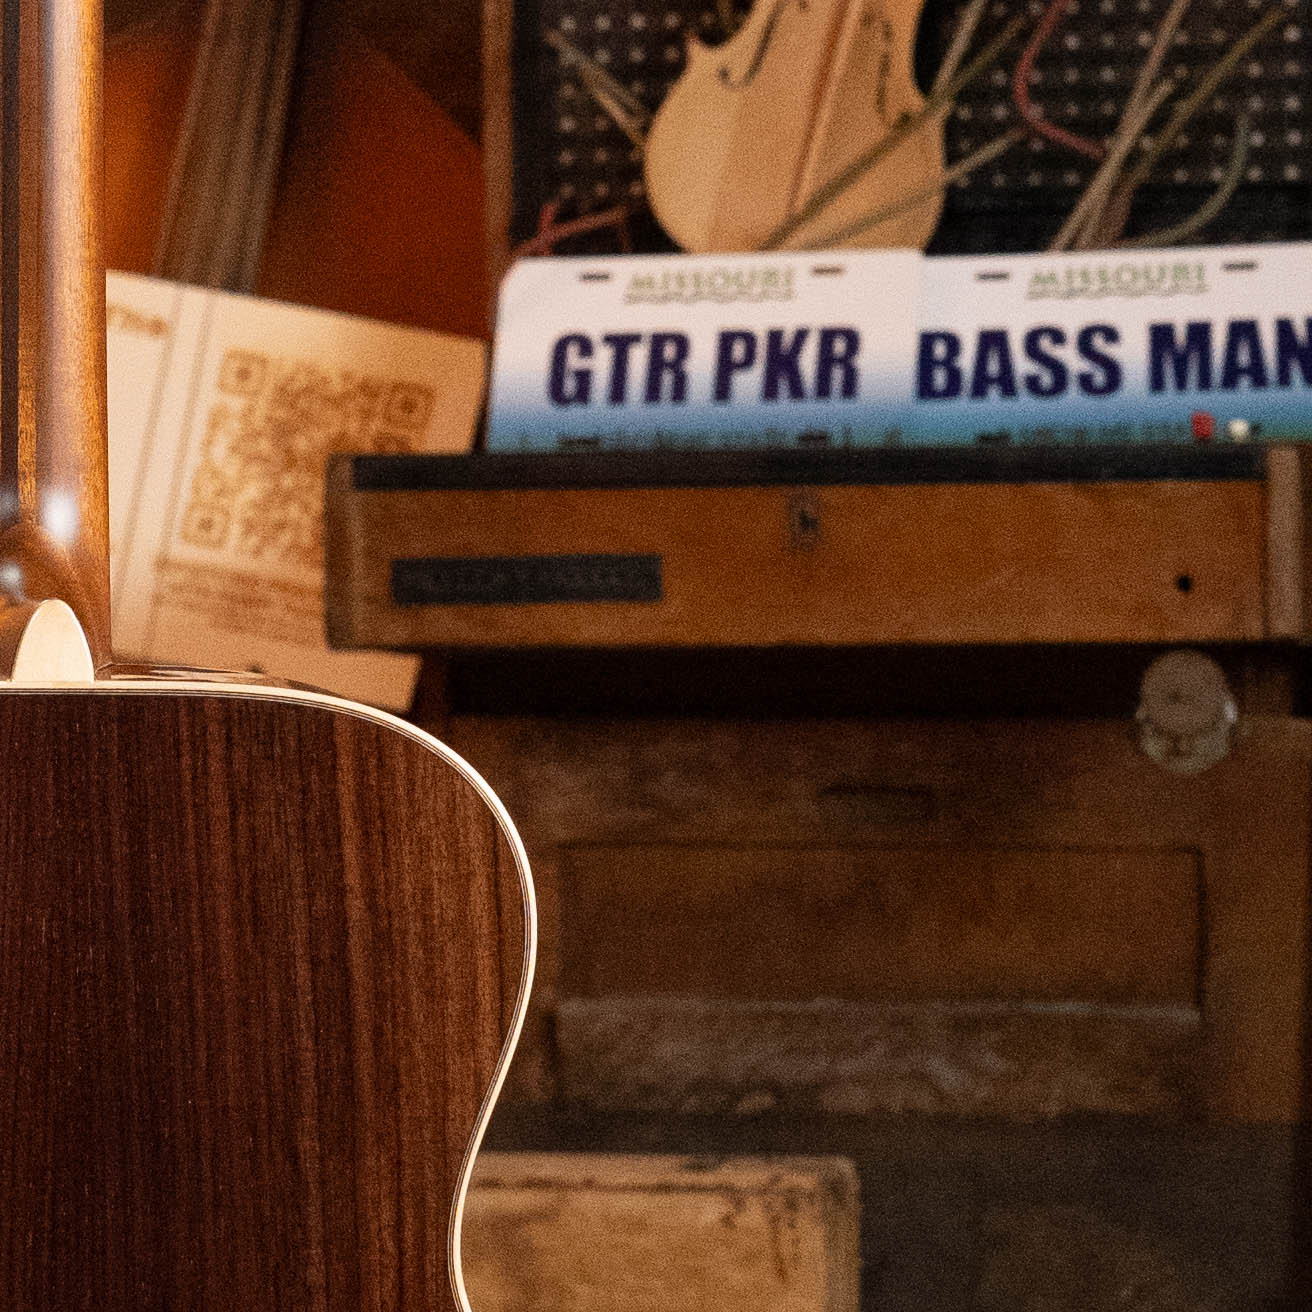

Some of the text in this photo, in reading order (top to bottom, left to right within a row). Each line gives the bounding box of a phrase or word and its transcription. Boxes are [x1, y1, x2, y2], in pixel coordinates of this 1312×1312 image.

[627, 267, 795, 297] MISSOURI
[1029, 260, 1210, 294] MISSOURI
[548, 327, 862, 407] GTR PKR
[916, 317, 1312, 402] BASS MAN
